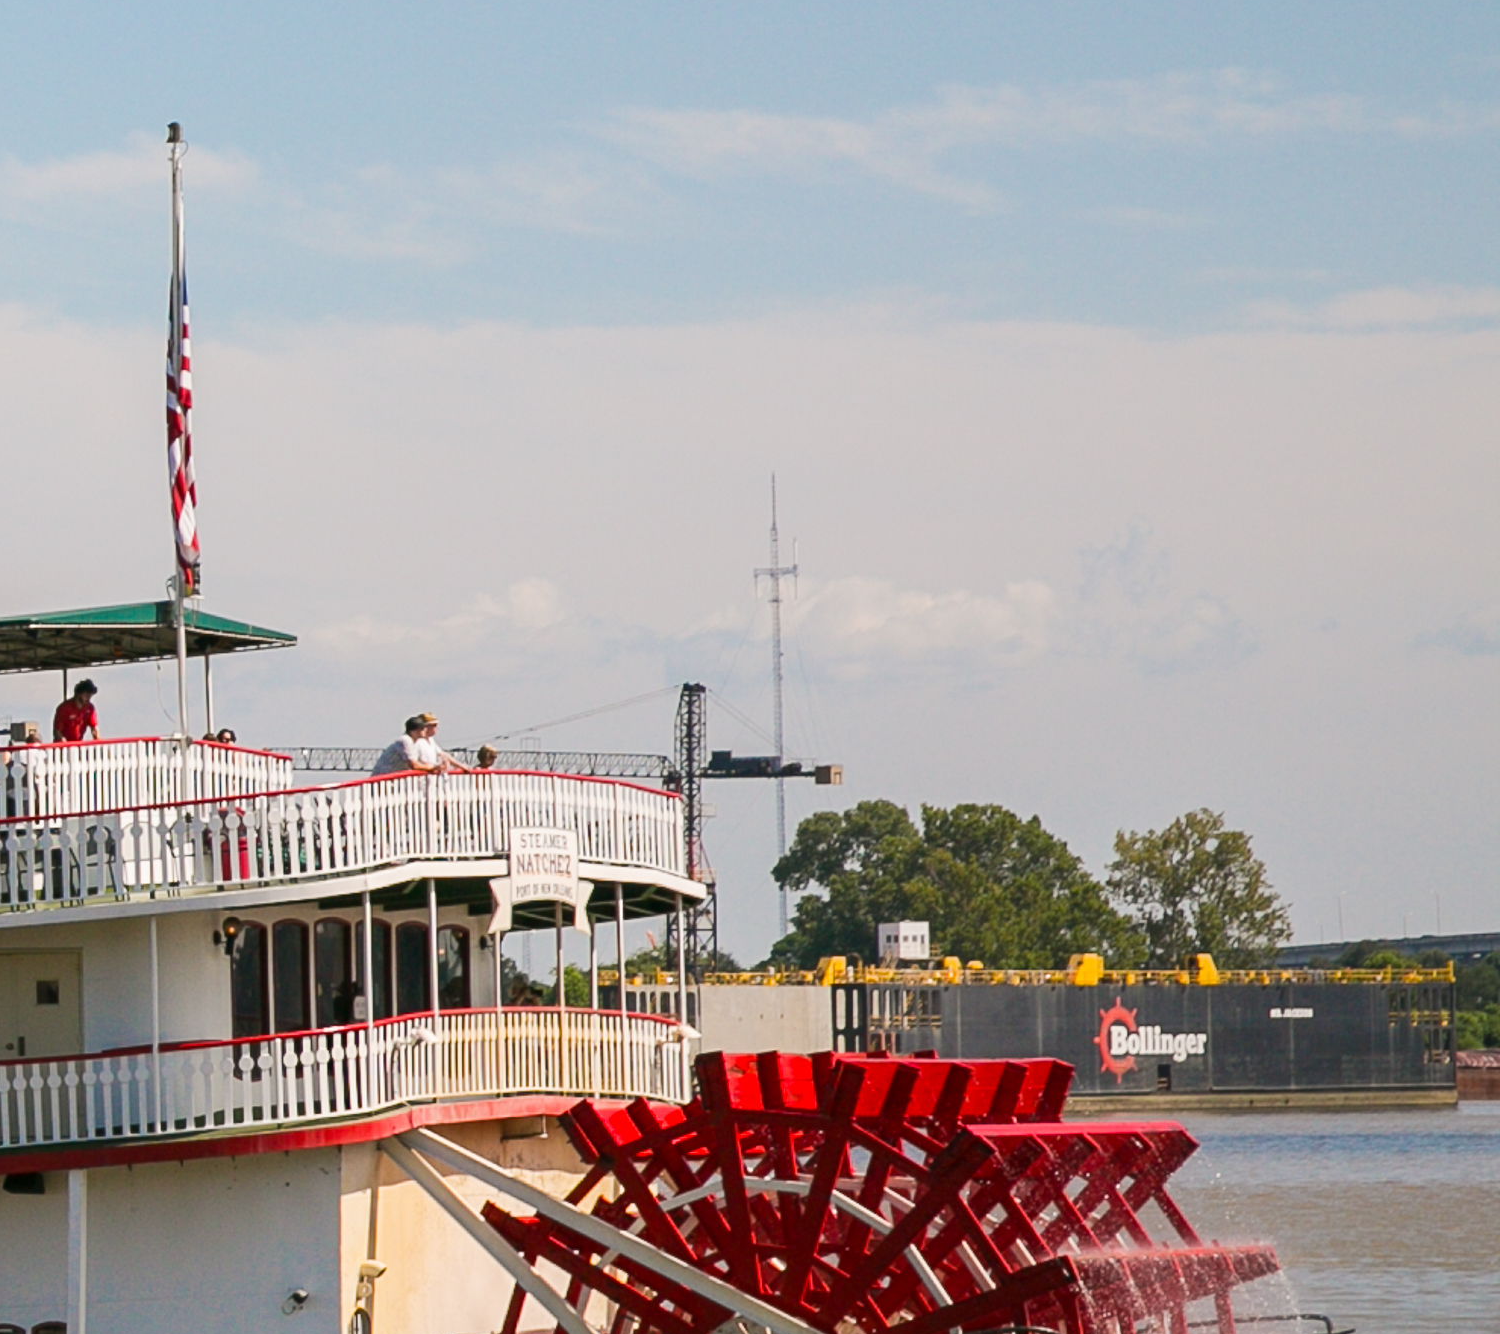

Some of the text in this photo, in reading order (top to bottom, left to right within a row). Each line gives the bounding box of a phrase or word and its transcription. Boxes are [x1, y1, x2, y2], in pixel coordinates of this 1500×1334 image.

[520, 833, 568, 849] STEAMER
[516, 853, 572, 878] NATCHEZ
[1109, 1025, 1207, 1063] Bollinger
